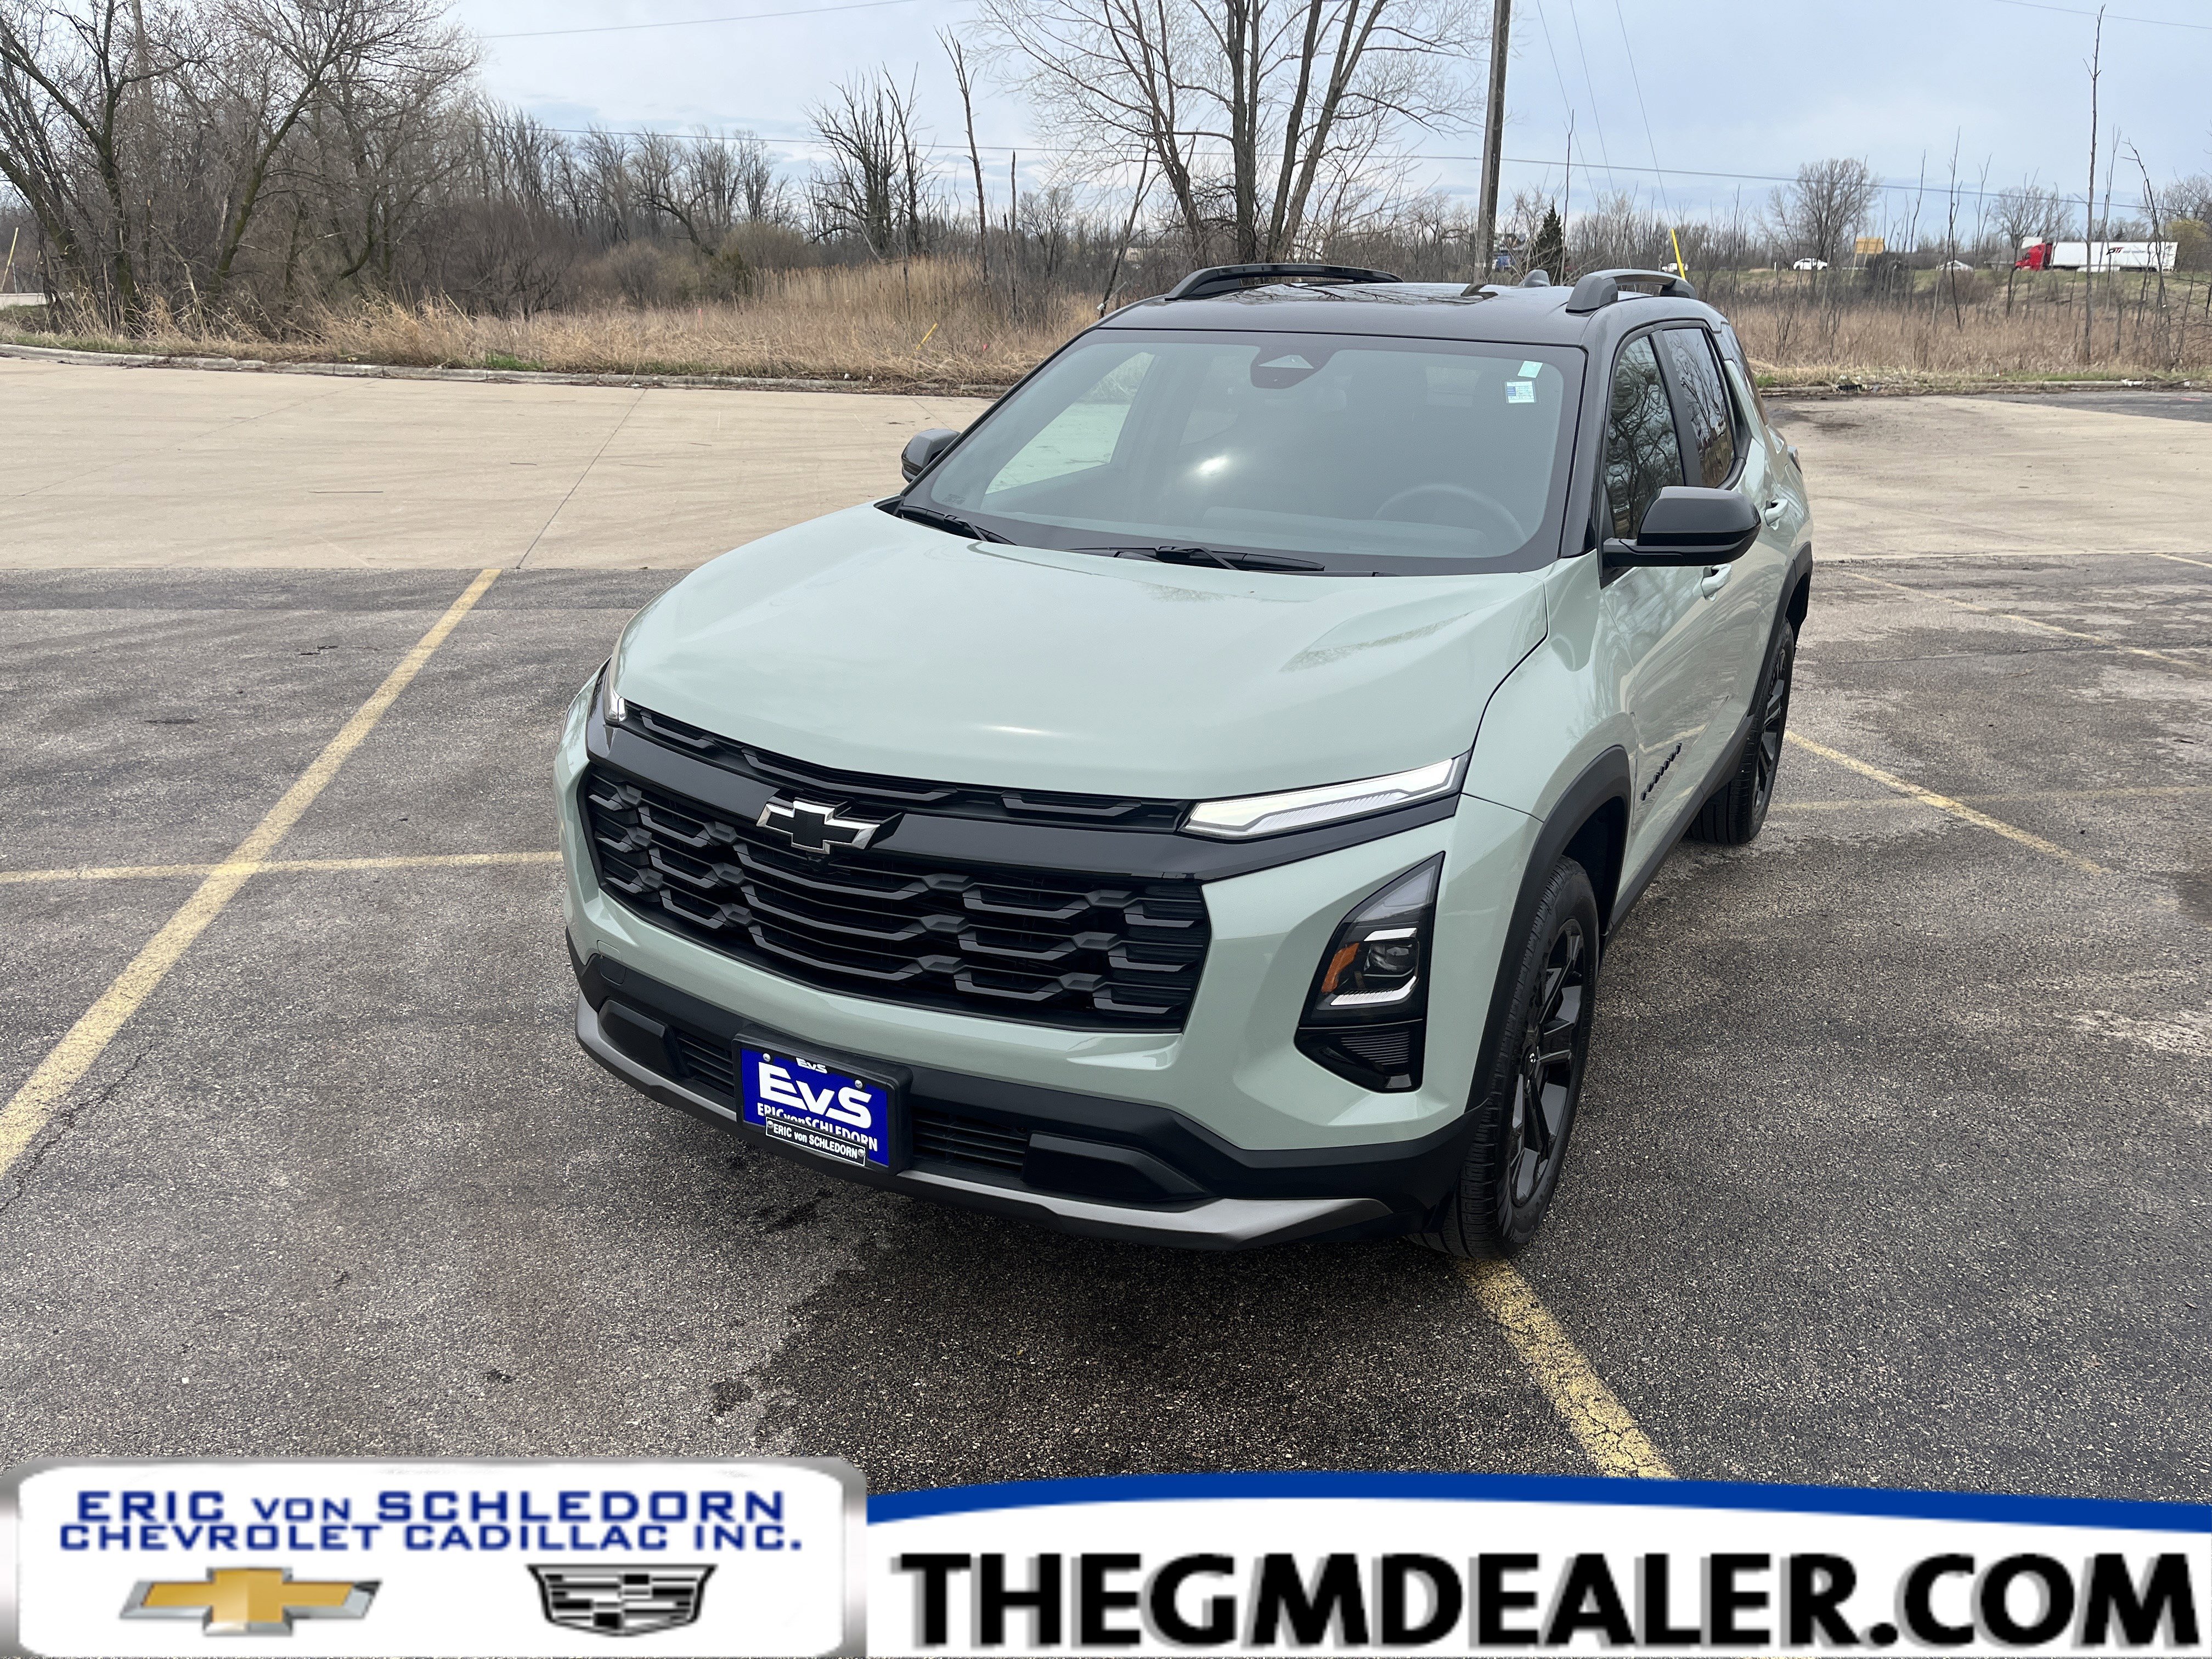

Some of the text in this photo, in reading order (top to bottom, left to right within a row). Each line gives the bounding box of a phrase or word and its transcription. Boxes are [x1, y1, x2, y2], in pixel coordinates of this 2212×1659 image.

[758, 1062, 872, 1129] EvS
[773, 1123, 858, 1159] ERIC von SCHLEDORN
